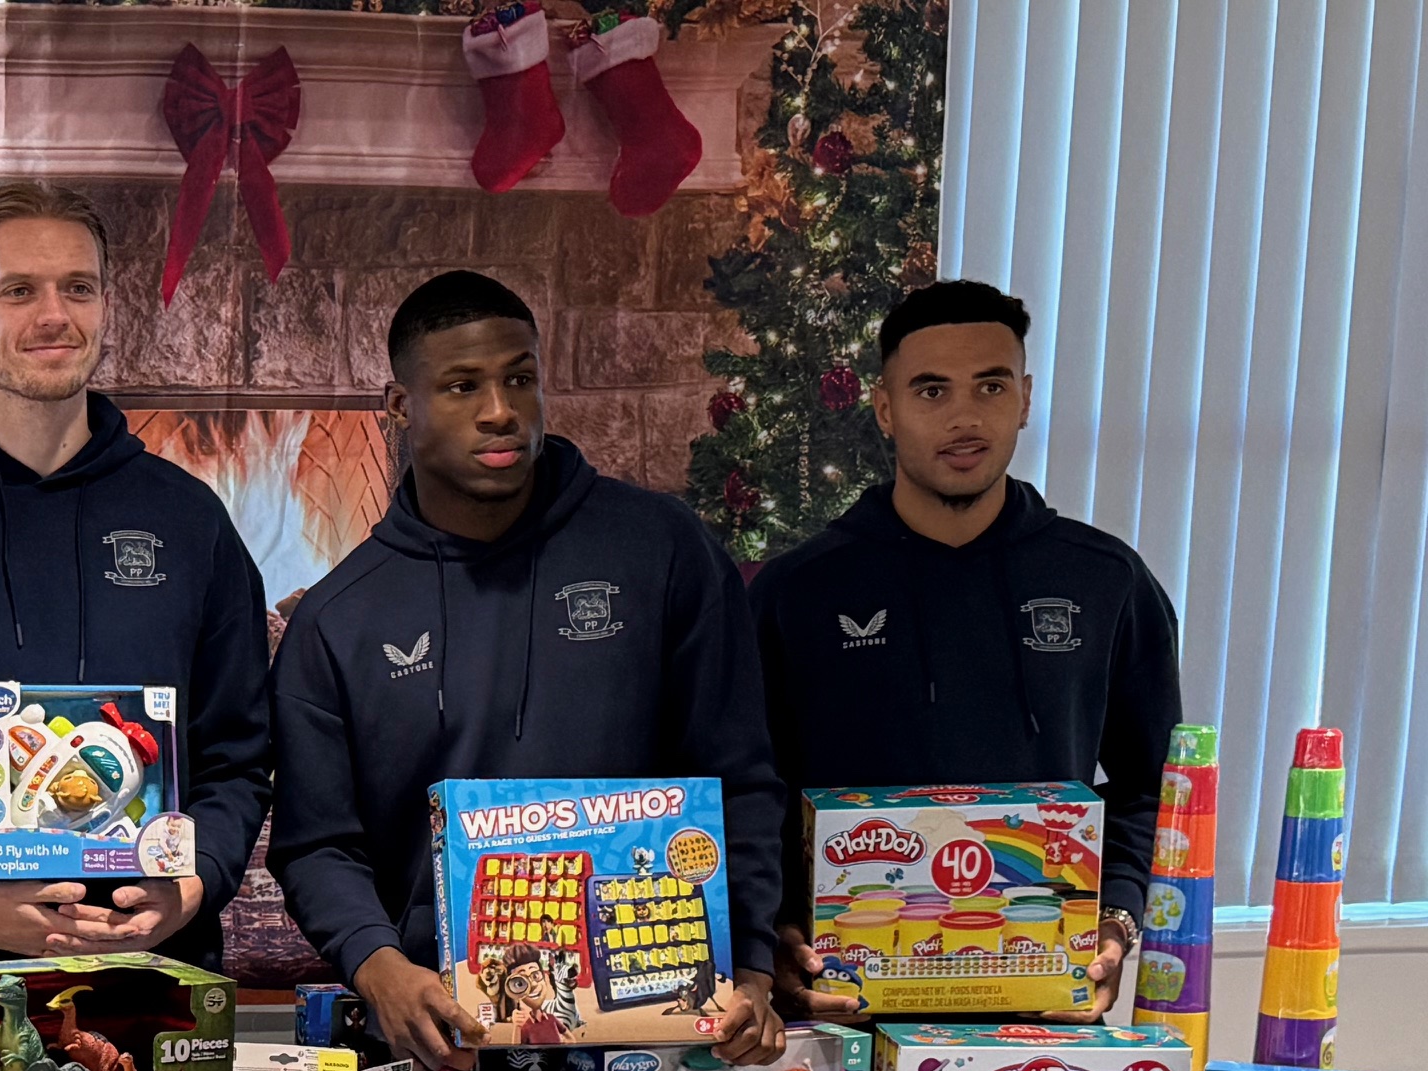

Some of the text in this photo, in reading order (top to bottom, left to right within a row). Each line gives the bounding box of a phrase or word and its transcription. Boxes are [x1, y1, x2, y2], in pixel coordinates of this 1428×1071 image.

[129, 568, 143, 578] PP
[584, 620, 598, 631] PP
[842, 637, 887, 649] CASTORE
[1047, 634, 1060, 643] PP
[390, 661, 434, 679] CASTORE
[460, 786, 685, 840] WHO'S WHO?
[492, 826, 615, 848] RACE TO GUESS THE RIGHT FACE!
[826, 824, 924, 863] Play-Doh
[5, 845, 22, 858] Fly
[24, 845, 50, 856] with
[52, 845, 69, 855] Me
[941, 846, 982, 880] 40
[160, 1039, 190, 1063] 10
[191, 1037, 229, 1052] Pieces
[851, 1042, 860, 1053] 6
